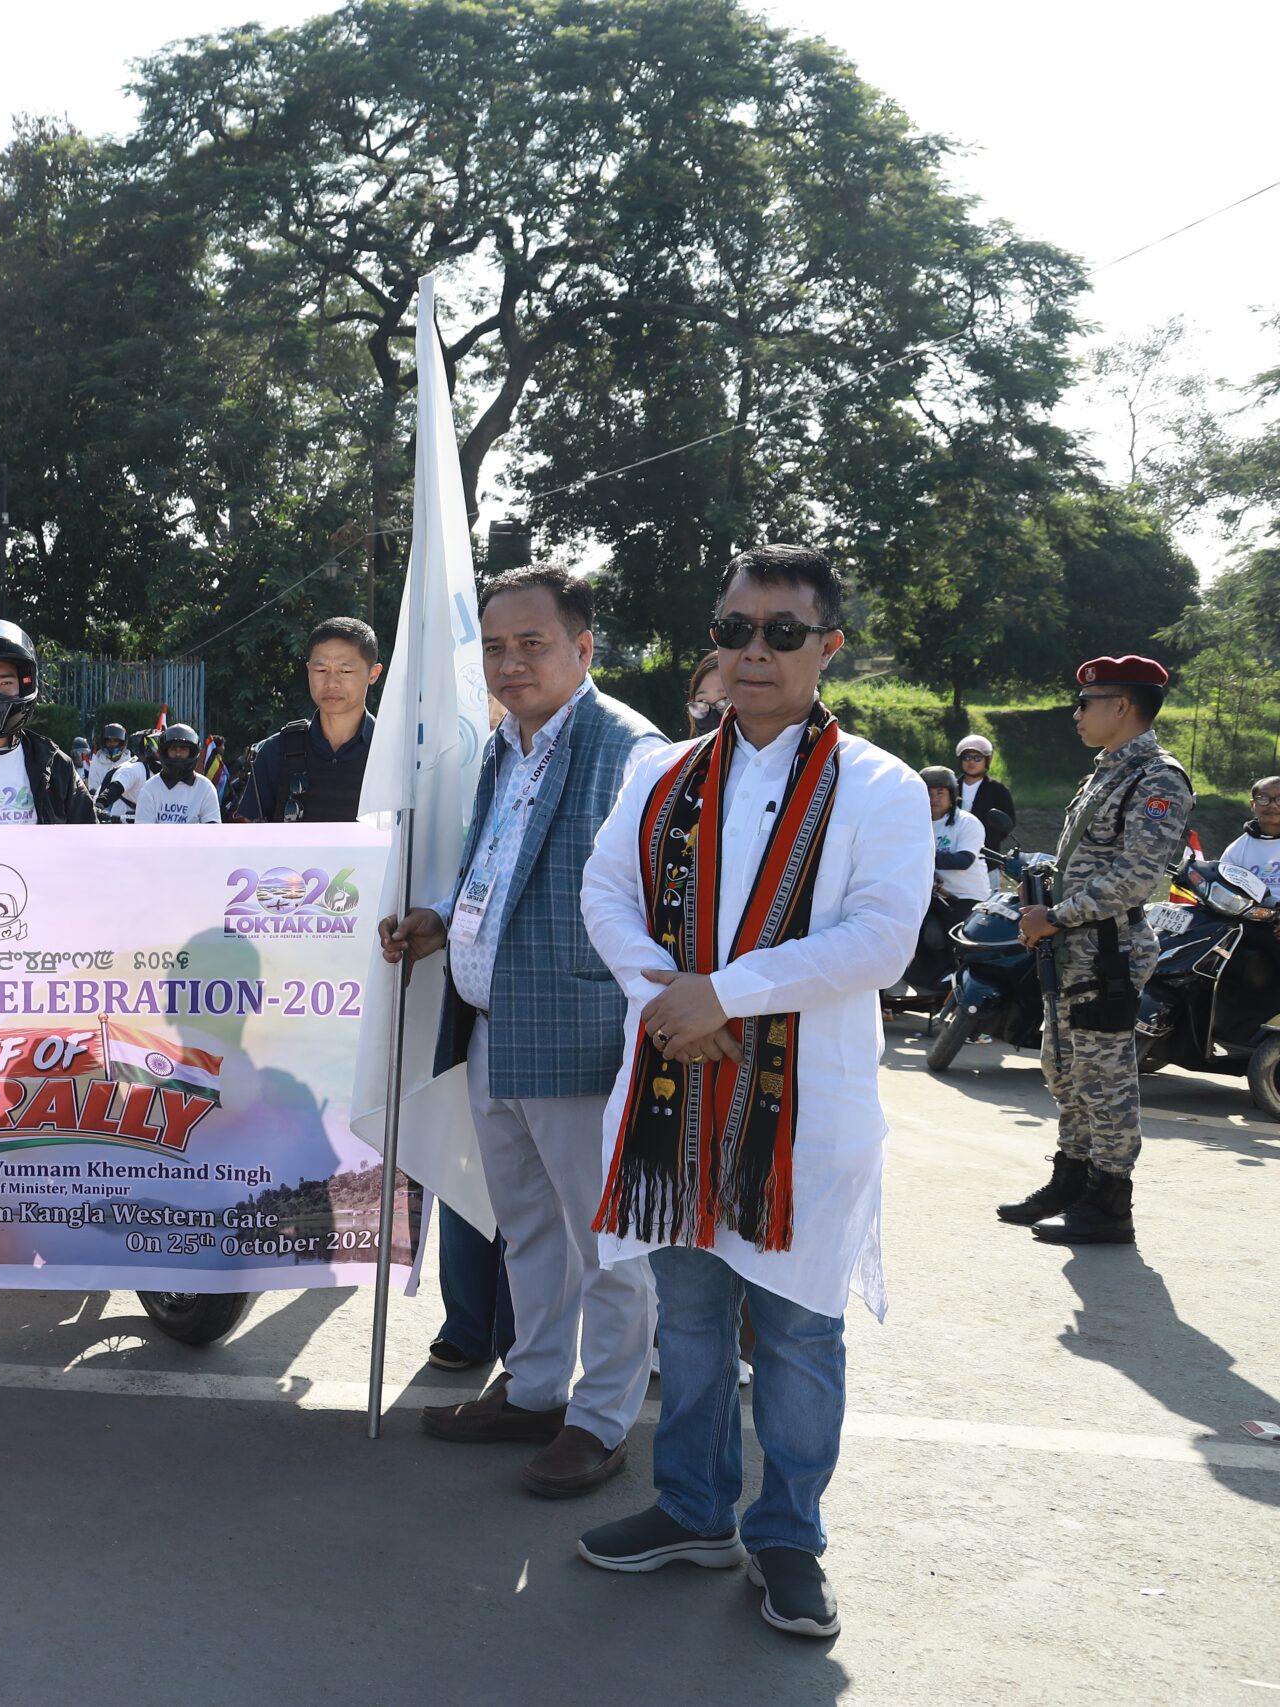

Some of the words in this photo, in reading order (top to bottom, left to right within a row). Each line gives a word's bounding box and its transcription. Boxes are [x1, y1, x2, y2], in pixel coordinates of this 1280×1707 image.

[530, 747, 555, 782] LOKTAK
[14, 810, 33, 820] DAY
[165, 803, 188, 814] LOVE
[224, 867, 360, 916] 2026
[223, 917, 314, 933] LOKTAK
[317, 917, 359, 933] DAY
[33, 1031, 96, 1071] OF
[87, 1162, 209, 1180] Khemchand
[215, 1165, 271, 1186] Singh
[9, 1183, 68, 1195] Minister,
[71, 1183, 130, 1197] Manipur
[19, 1202, 105, 1228] Kangla
[112, 1203, 216, 1227] Western
[222, 1208, 279, 1229] Gate
[126, 1232, 161, 1252] On
[168, 1233, 216, 1254] 25th
[221, 1234, 320, 1255] October
